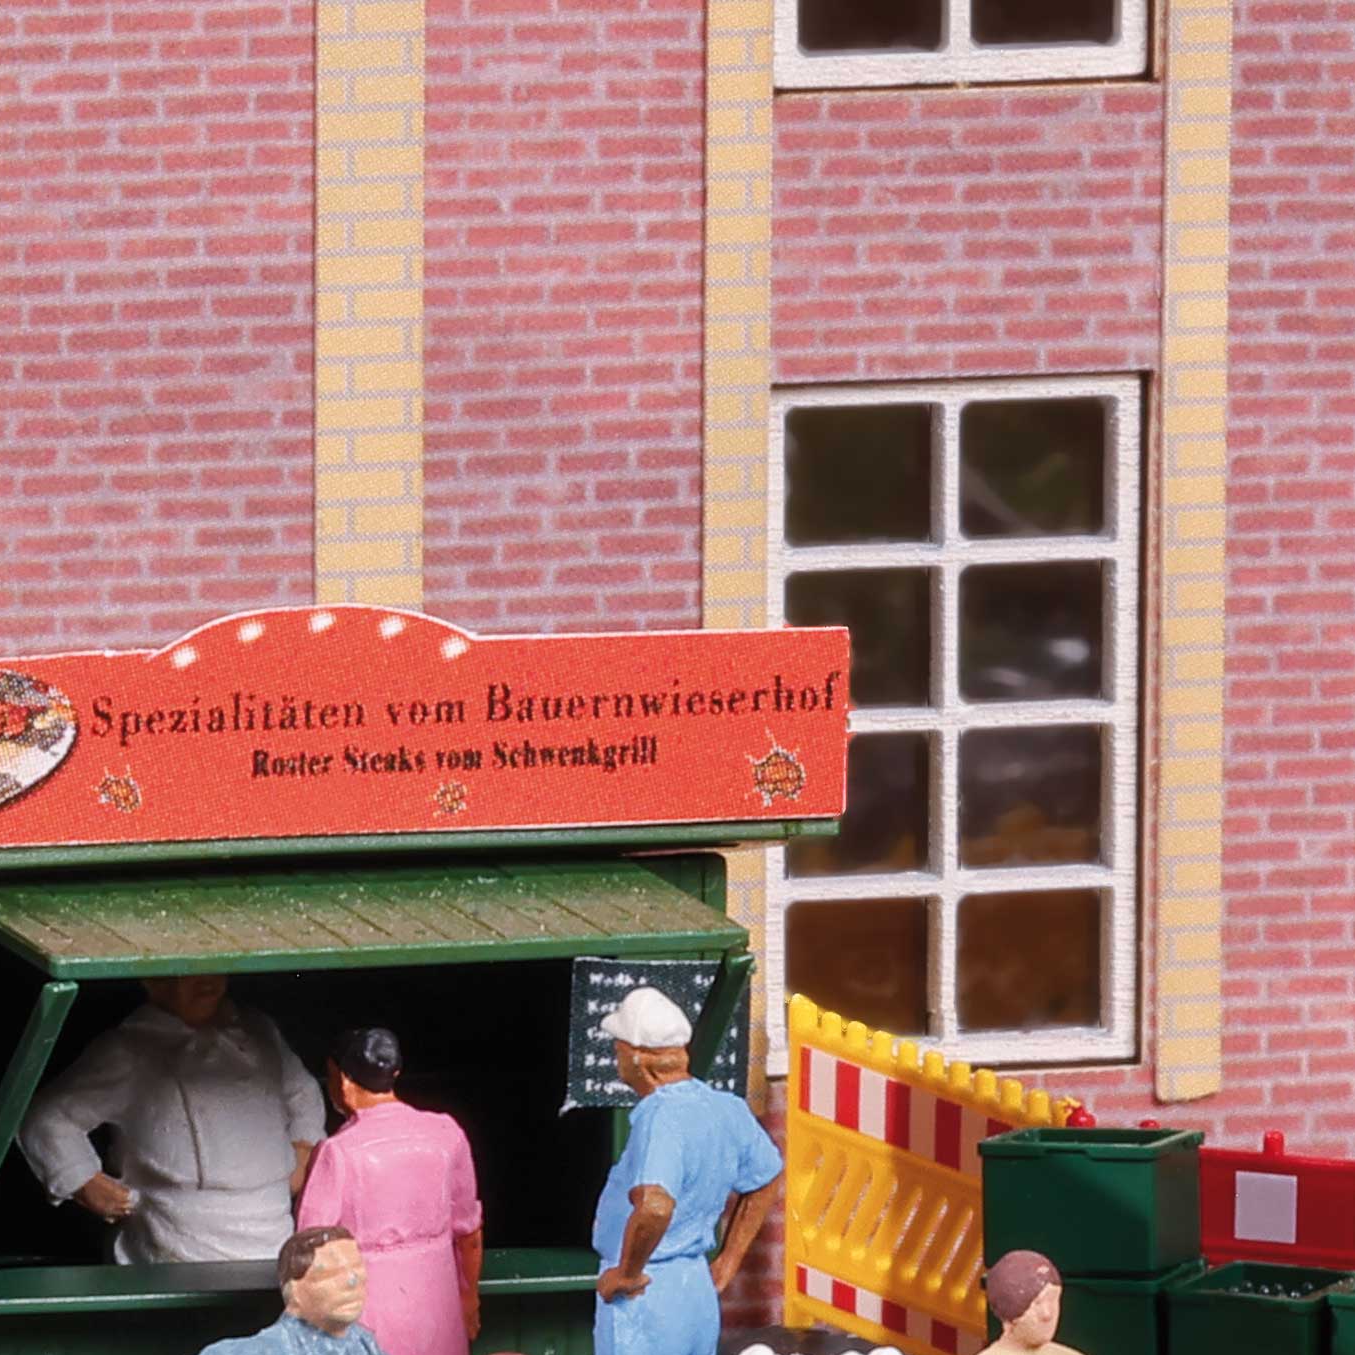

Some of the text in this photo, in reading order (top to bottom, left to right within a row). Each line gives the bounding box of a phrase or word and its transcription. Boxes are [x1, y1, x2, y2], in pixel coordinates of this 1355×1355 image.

[91, 671, 841, 747] Spezialitäten vom Bauernwieserhof
[343, 745, 425, 774] Steaks
[435, 746, 483, 770] vom
[492, 735, 658, 772] Schwenkgrill
